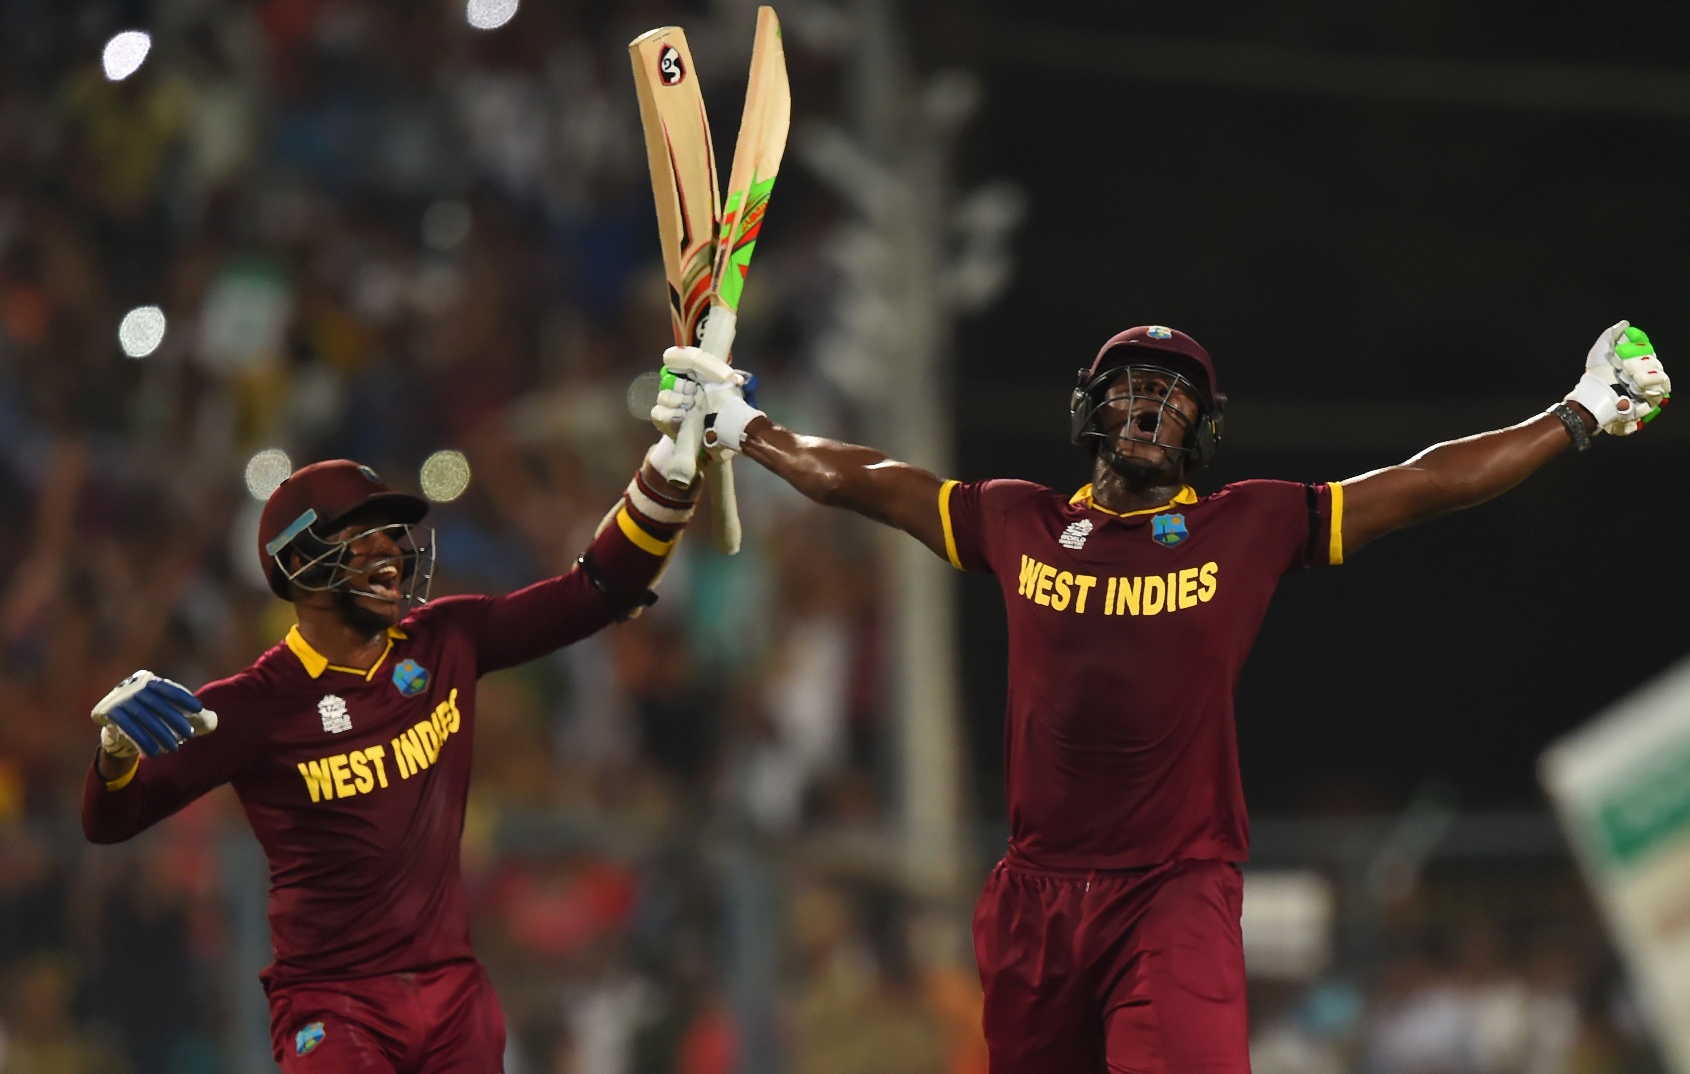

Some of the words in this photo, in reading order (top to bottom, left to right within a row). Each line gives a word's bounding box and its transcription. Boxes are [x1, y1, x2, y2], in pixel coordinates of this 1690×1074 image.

[1018, 554, 1097, 614] WEST
[1104, 561, 1219, 616] INDIES
[297, 745, 388, 803] WEST
[391, 688, 460, 780] INDIES
